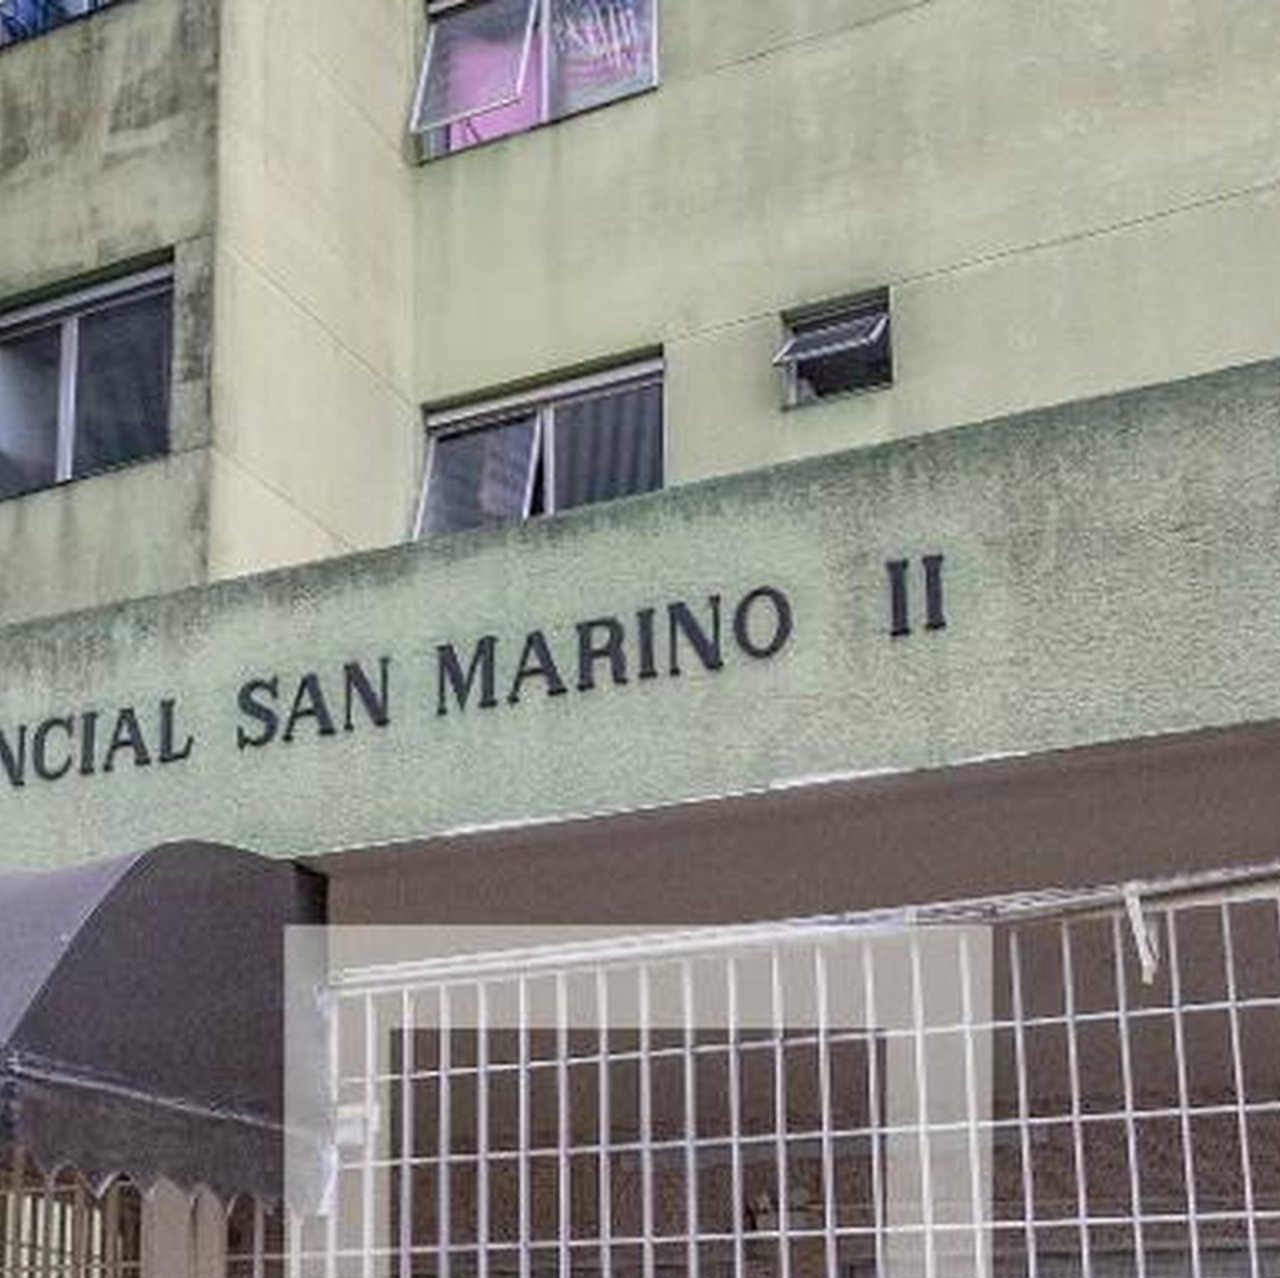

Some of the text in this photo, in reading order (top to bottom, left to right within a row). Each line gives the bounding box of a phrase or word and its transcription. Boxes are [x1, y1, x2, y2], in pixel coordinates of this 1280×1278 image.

[236, 656, 391, 750] SAN
[435, 585, 793, 717] MARINO
[886, 553, 946, 637] II
